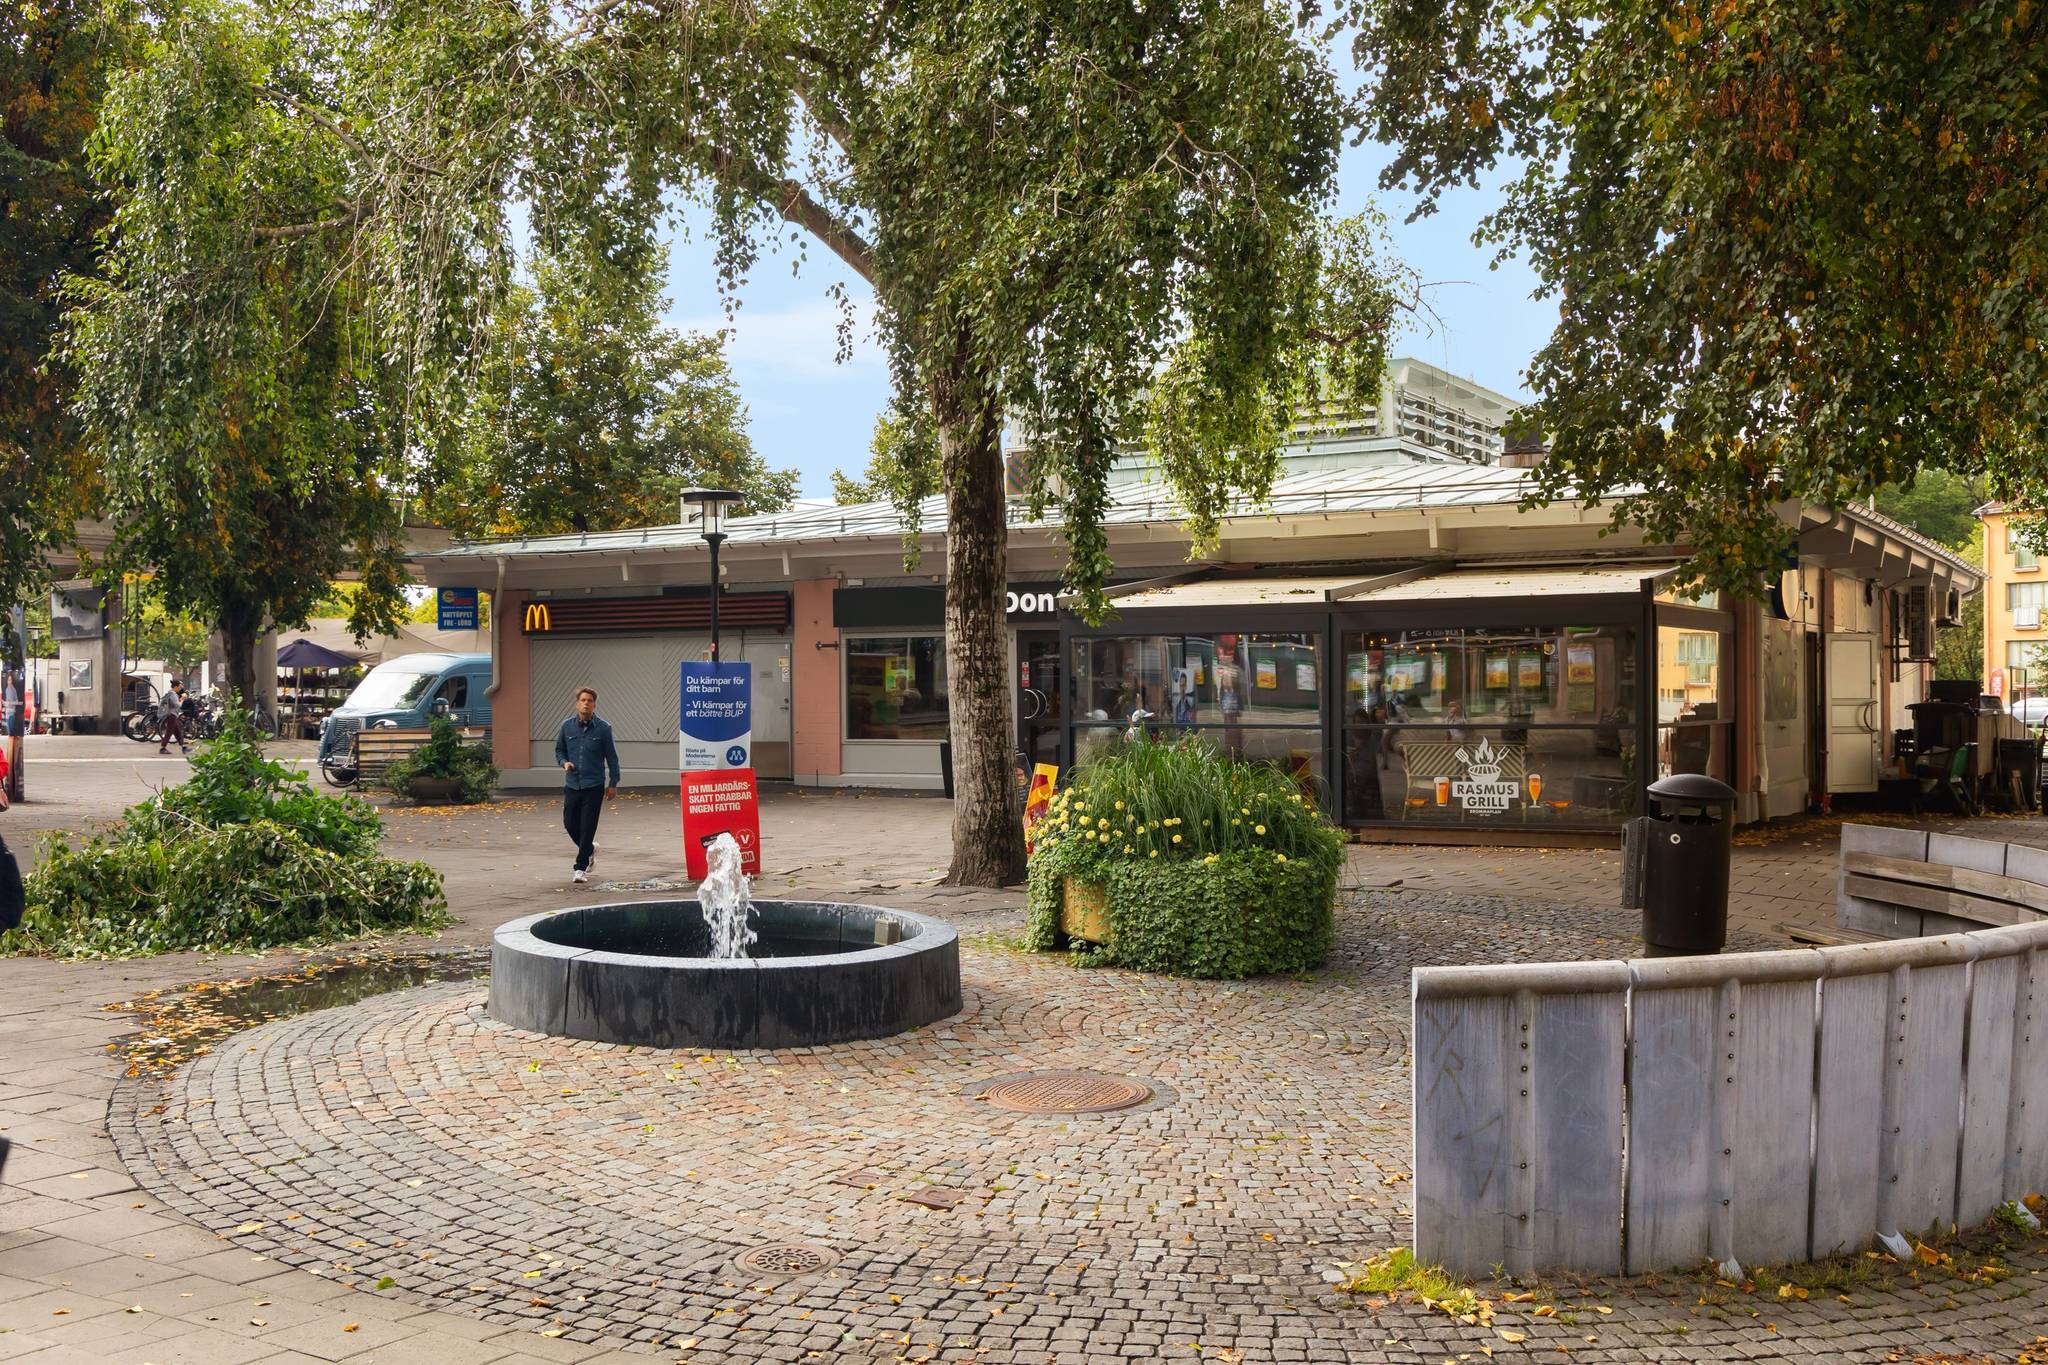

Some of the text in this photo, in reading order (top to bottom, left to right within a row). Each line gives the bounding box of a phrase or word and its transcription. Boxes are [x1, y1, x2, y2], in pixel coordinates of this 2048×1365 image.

[686, 676, 745, 686] Du kämpar för
[686, 685, 721, 693] ditt barn
[692, 700, 701, 709] Vi
[702, 700, 734, 710] kämpar
[735, 700, 748, 709] för
[686, 709, 744, 718] ett bättre BUP
[688, 780, 752, 794] EN MILJARDÄRS-
[1457, 784, 1515, 795] RASMUS
[688, 791, 752, 804] SKATT DRABBAR
[1467, 796, 1505, 807] GRILL
[689, 802, 741, 814] INGEN FATTIG
[740, 834, 750, 844] V
